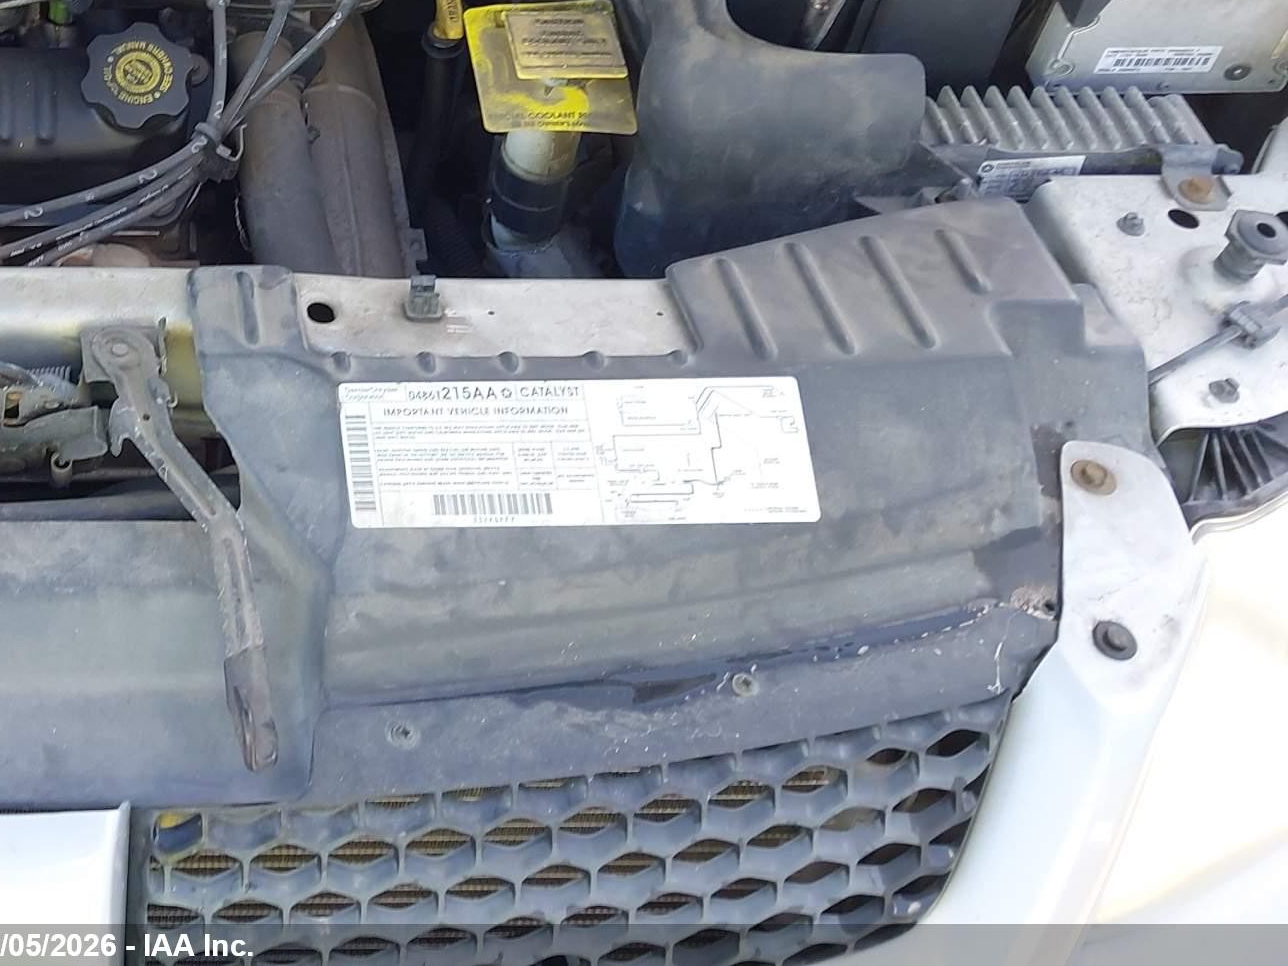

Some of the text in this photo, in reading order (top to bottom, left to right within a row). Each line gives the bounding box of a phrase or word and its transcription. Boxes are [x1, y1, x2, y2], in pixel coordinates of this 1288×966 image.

[520, 386, 579, 397] CATALYST
[384, 406, 568, 417] IMPORTANT VEHICLE INFORMATION
